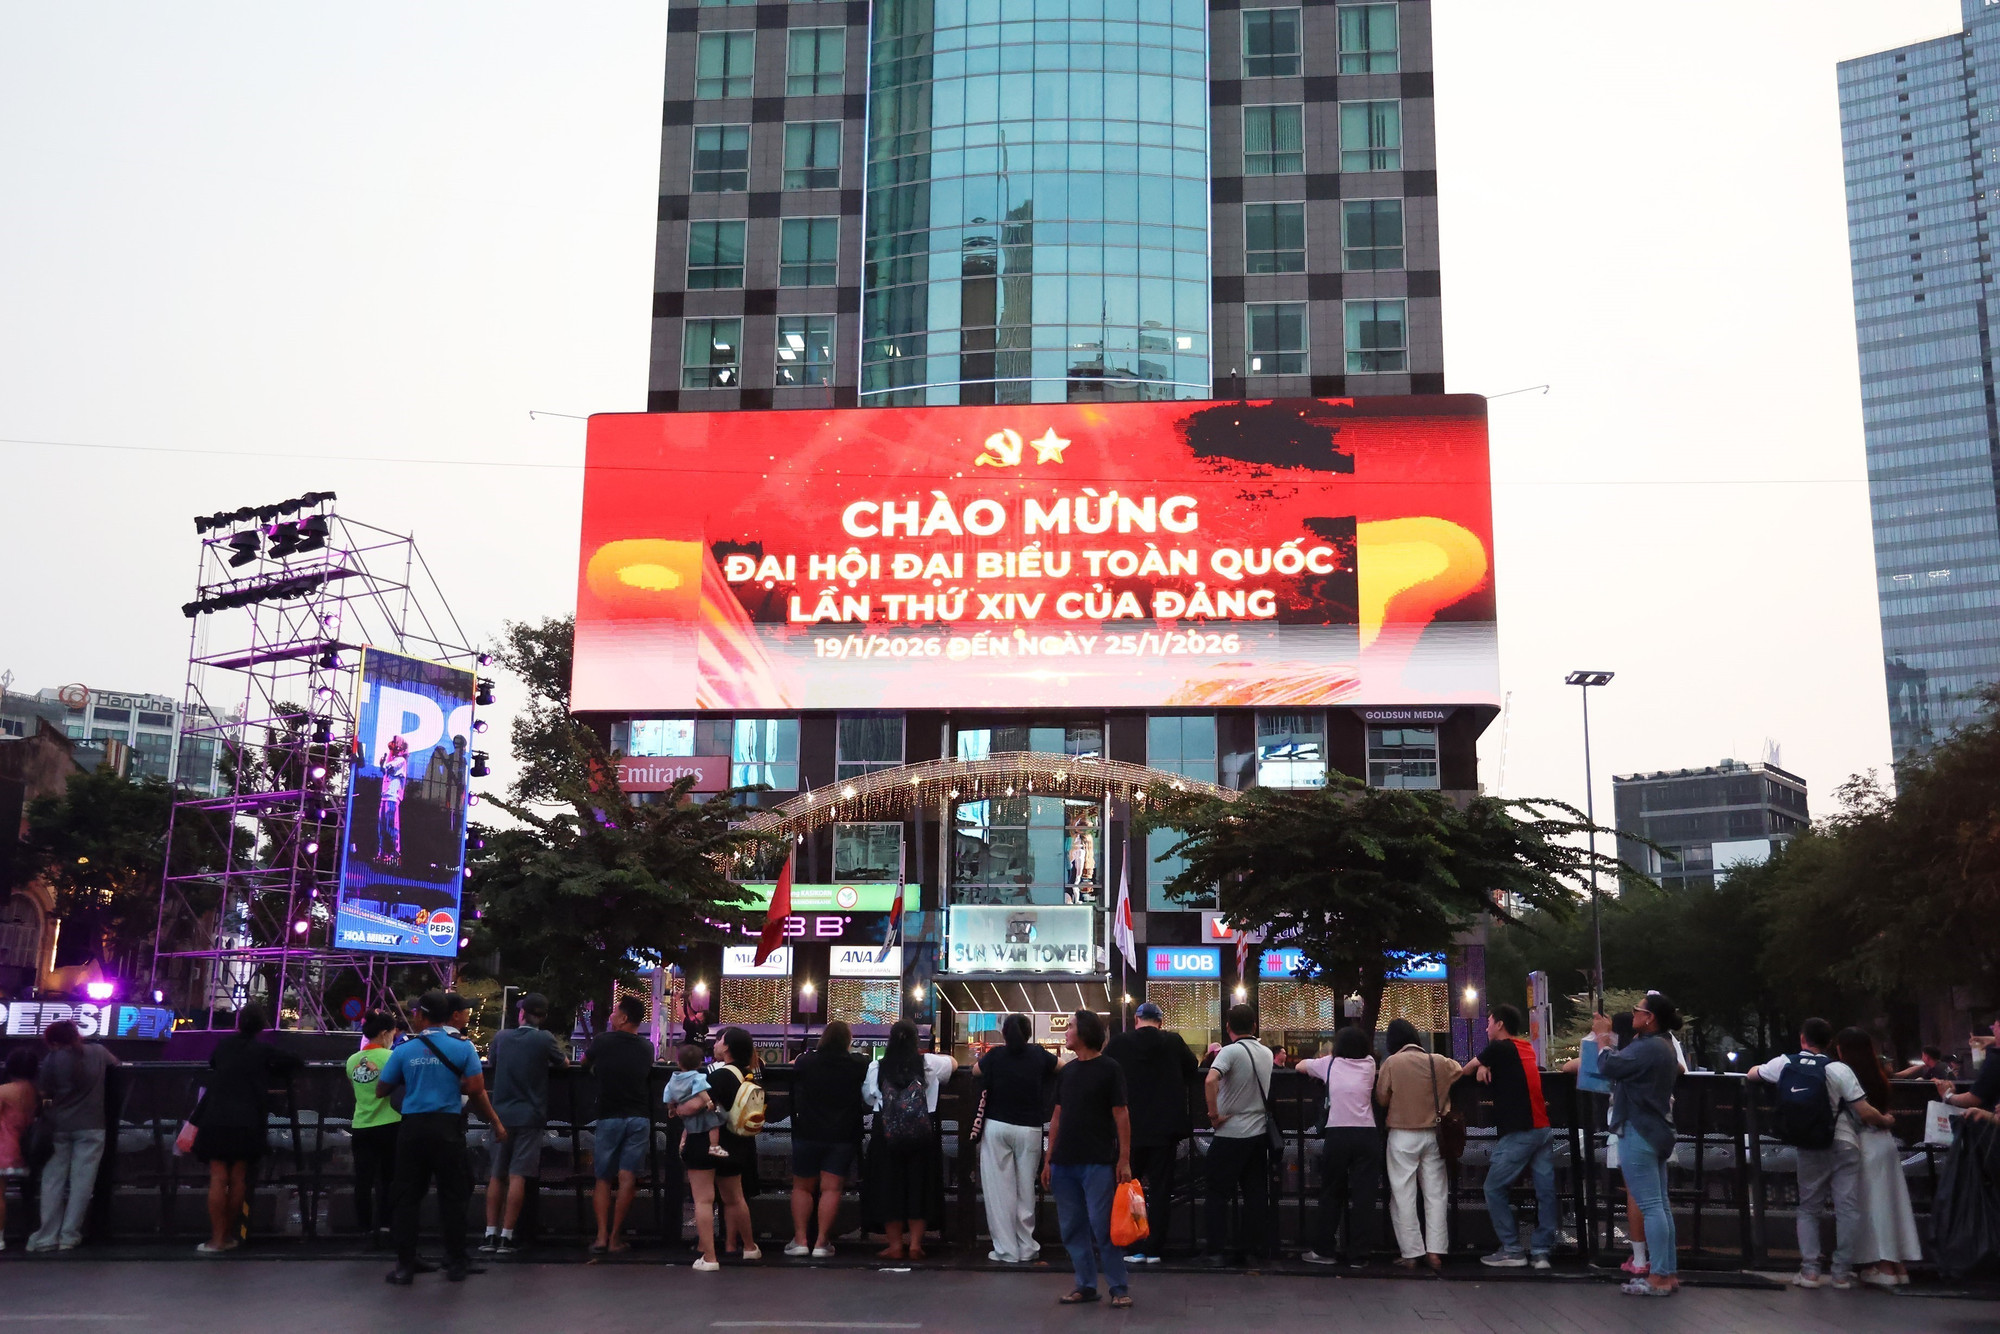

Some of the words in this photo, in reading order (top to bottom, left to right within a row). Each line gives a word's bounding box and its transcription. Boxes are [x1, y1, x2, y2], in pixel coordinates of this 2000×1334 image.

[842, 490, 1006, 537] CHÀO
[1024, 488, 1198, 535] MỪNG
[724, 553, 795, 589] ĐẠI
[809, 547, 880, 587] HỘI
[891, 552, 963, 586] ĐẠI
[977, 541, 1071, 578] BIỂU
[1083, 544, 1198, 577] TOÀN
[1211, 538, 1334, 580] QUỐC
[790, 587, 871, 622] LẦN
[882, 587, 968, 621] THỨ
[976, 592, 1046, 620] XIV
[1056, 583, 1145, 620] CỦA
[1153, 582, 1277, 619] ĐẢNG
[814, 636, 941, 659] 19/1/2026
[948, 630, 1009, 657] ĐẾN
[1018, 633, 1097, 656] NGÀY
[1104, 633, 1240, 657] 25/1/2026
[97, 692, 173, 712] Hanwha
[177, 701, 208, 713] Life
[1366, 711, 1411, 719] GOLDSUN
[1414, 711, 1444, 719] MEDIA
[615, 764, 704, 782] Emirates
[430, 924, 454, 934] PEPSI
[735, 953, 783, 964] MIHO
[841, 951, 873, 962] ANA
[954, 943, 986, 962] SUN
[991, 943, 1027, 962] WAH
[1033, 943, 1088, 962] TOWER
[1174, 954, 1213, 970] UOB
[0, 1002, 111, 1036] EPSI
[410, 1056, 443, 1067] SECURI
